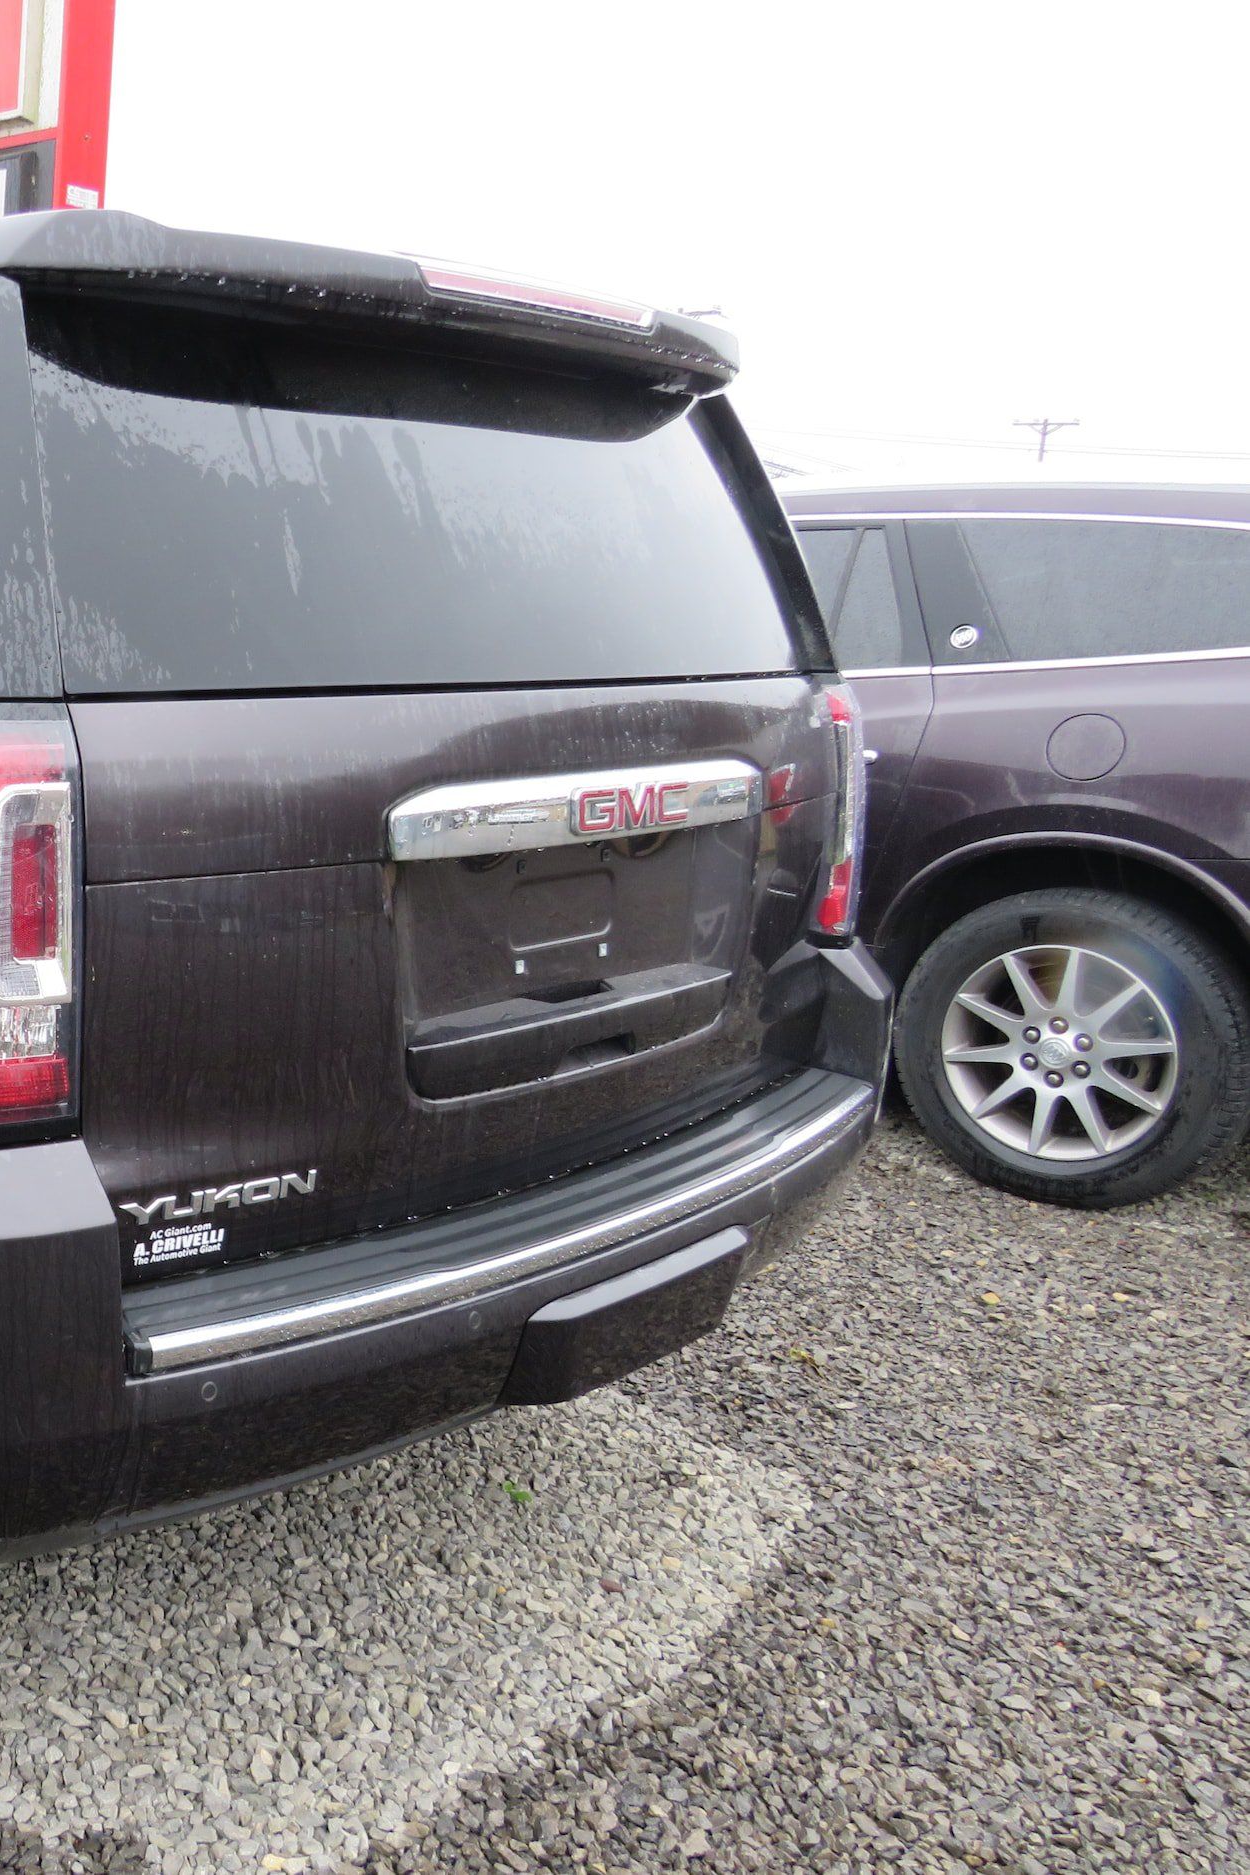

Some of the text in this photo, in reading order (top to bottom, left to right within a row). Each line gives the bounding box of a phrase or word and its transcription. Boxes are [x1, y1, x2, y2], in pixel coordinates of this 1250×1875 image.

[577, 781, 691, 833] GMC
[119, 1169, 317, 1225] YUKON
[133, 1228, 225, 1257] A. CRIVELLI
[149, 1222, 212, 1240] AC Giant.com
[133, 1242, 222, 1266] The Automotive Giant
